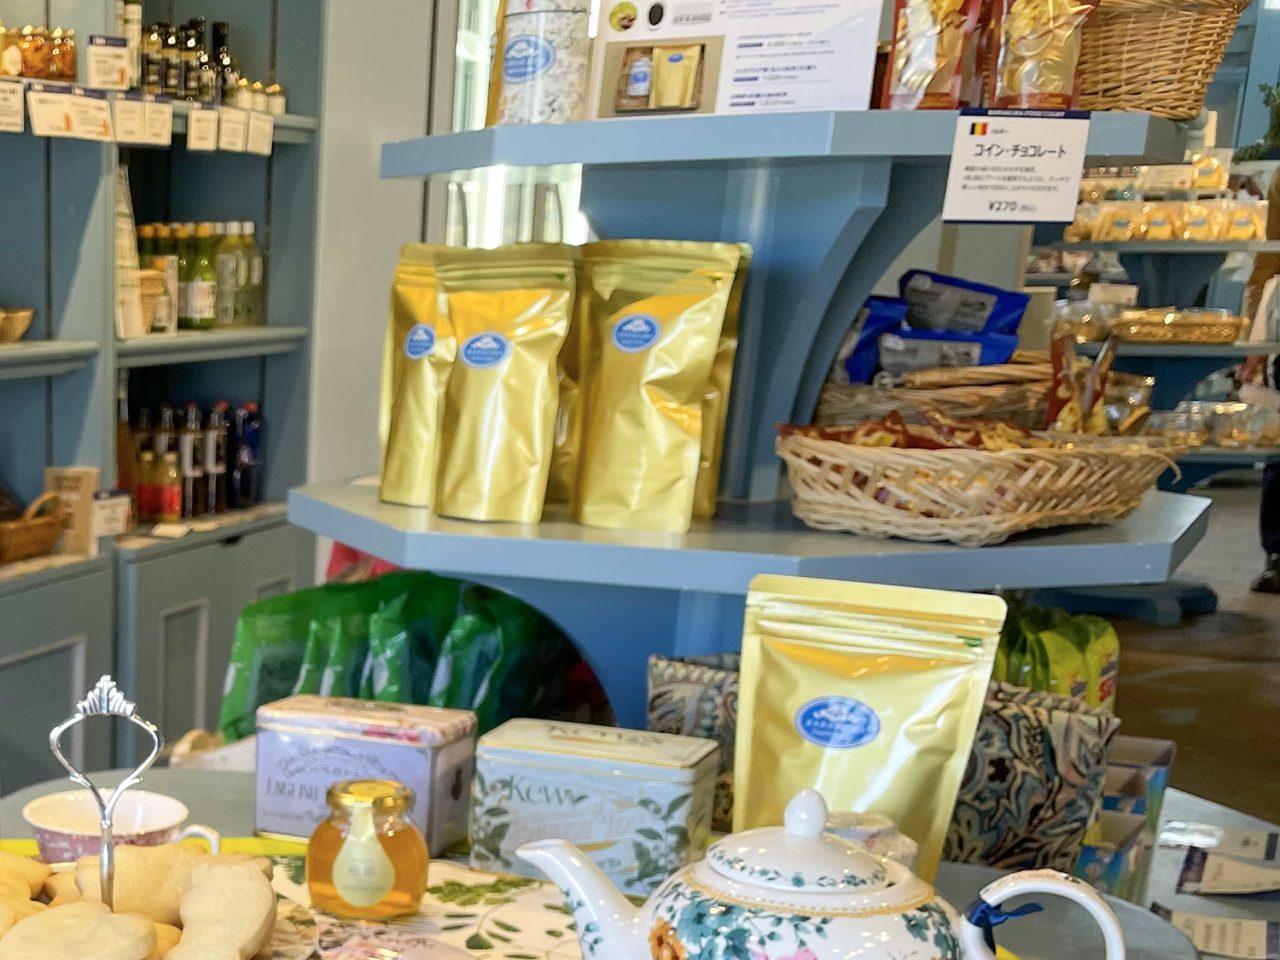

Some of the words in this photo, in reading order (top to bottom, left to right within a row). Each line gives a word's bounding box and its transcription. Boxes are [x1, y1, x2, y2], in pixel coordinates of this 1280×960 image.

[973, 143, 1067, 159] コイン・チョコレート
